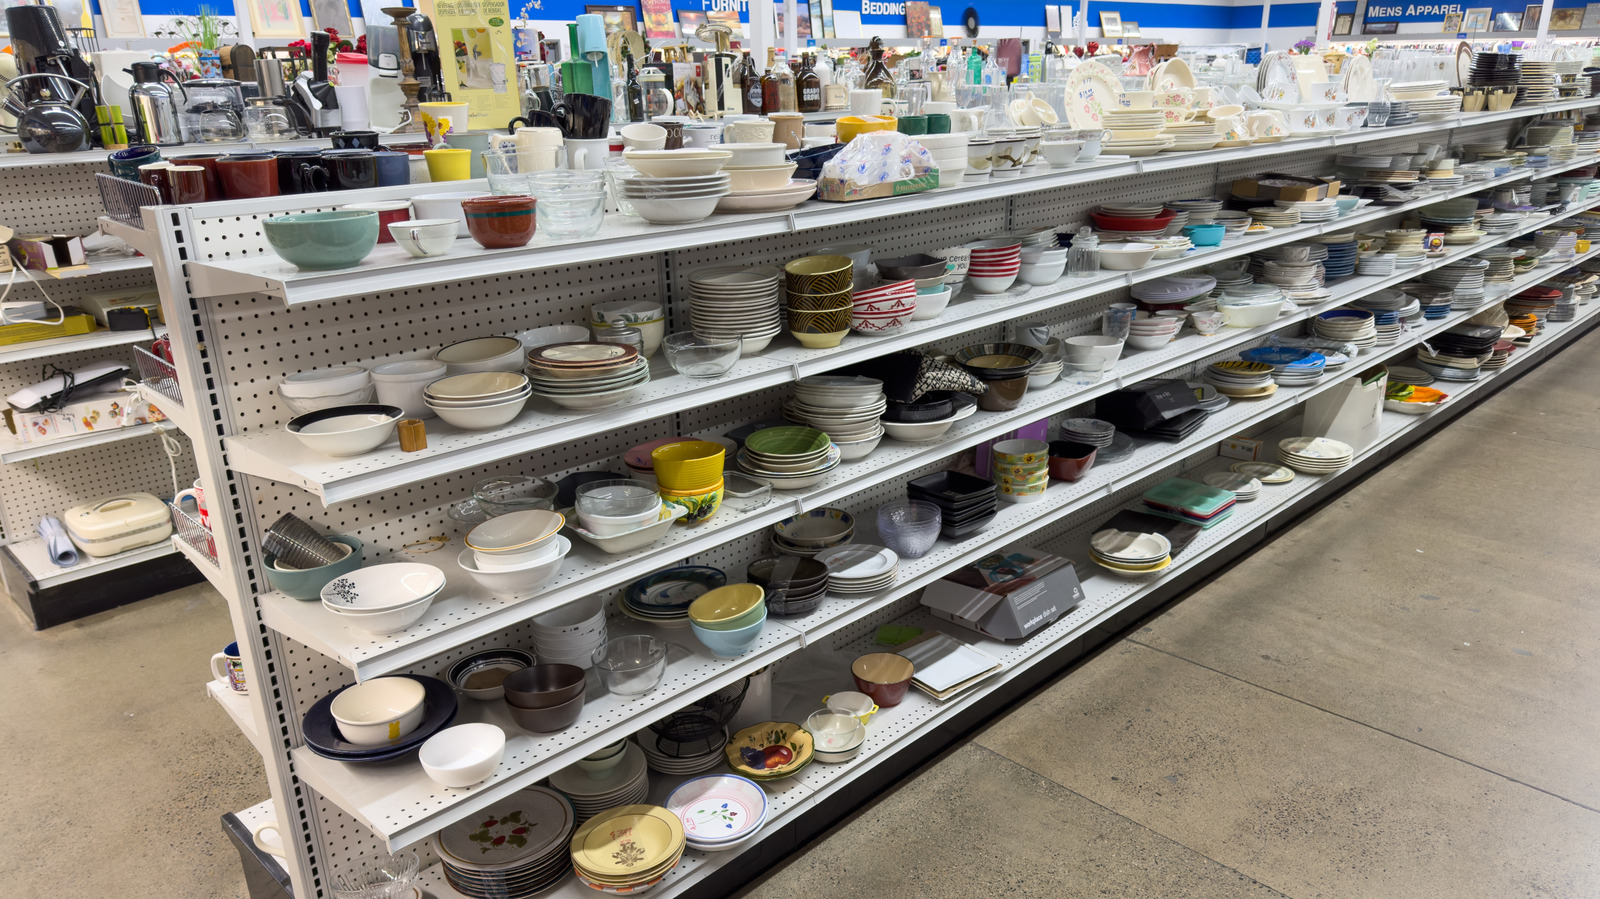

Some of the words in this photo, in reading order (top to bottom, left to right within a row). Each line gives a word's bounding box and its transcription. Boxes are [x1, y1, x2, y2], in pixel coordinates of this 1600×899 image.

[862, 0, 905, 15] BEDDING
[1368, 6, 1402, 17] MENS
[1405, 4, 1463, 16] APPAREL
